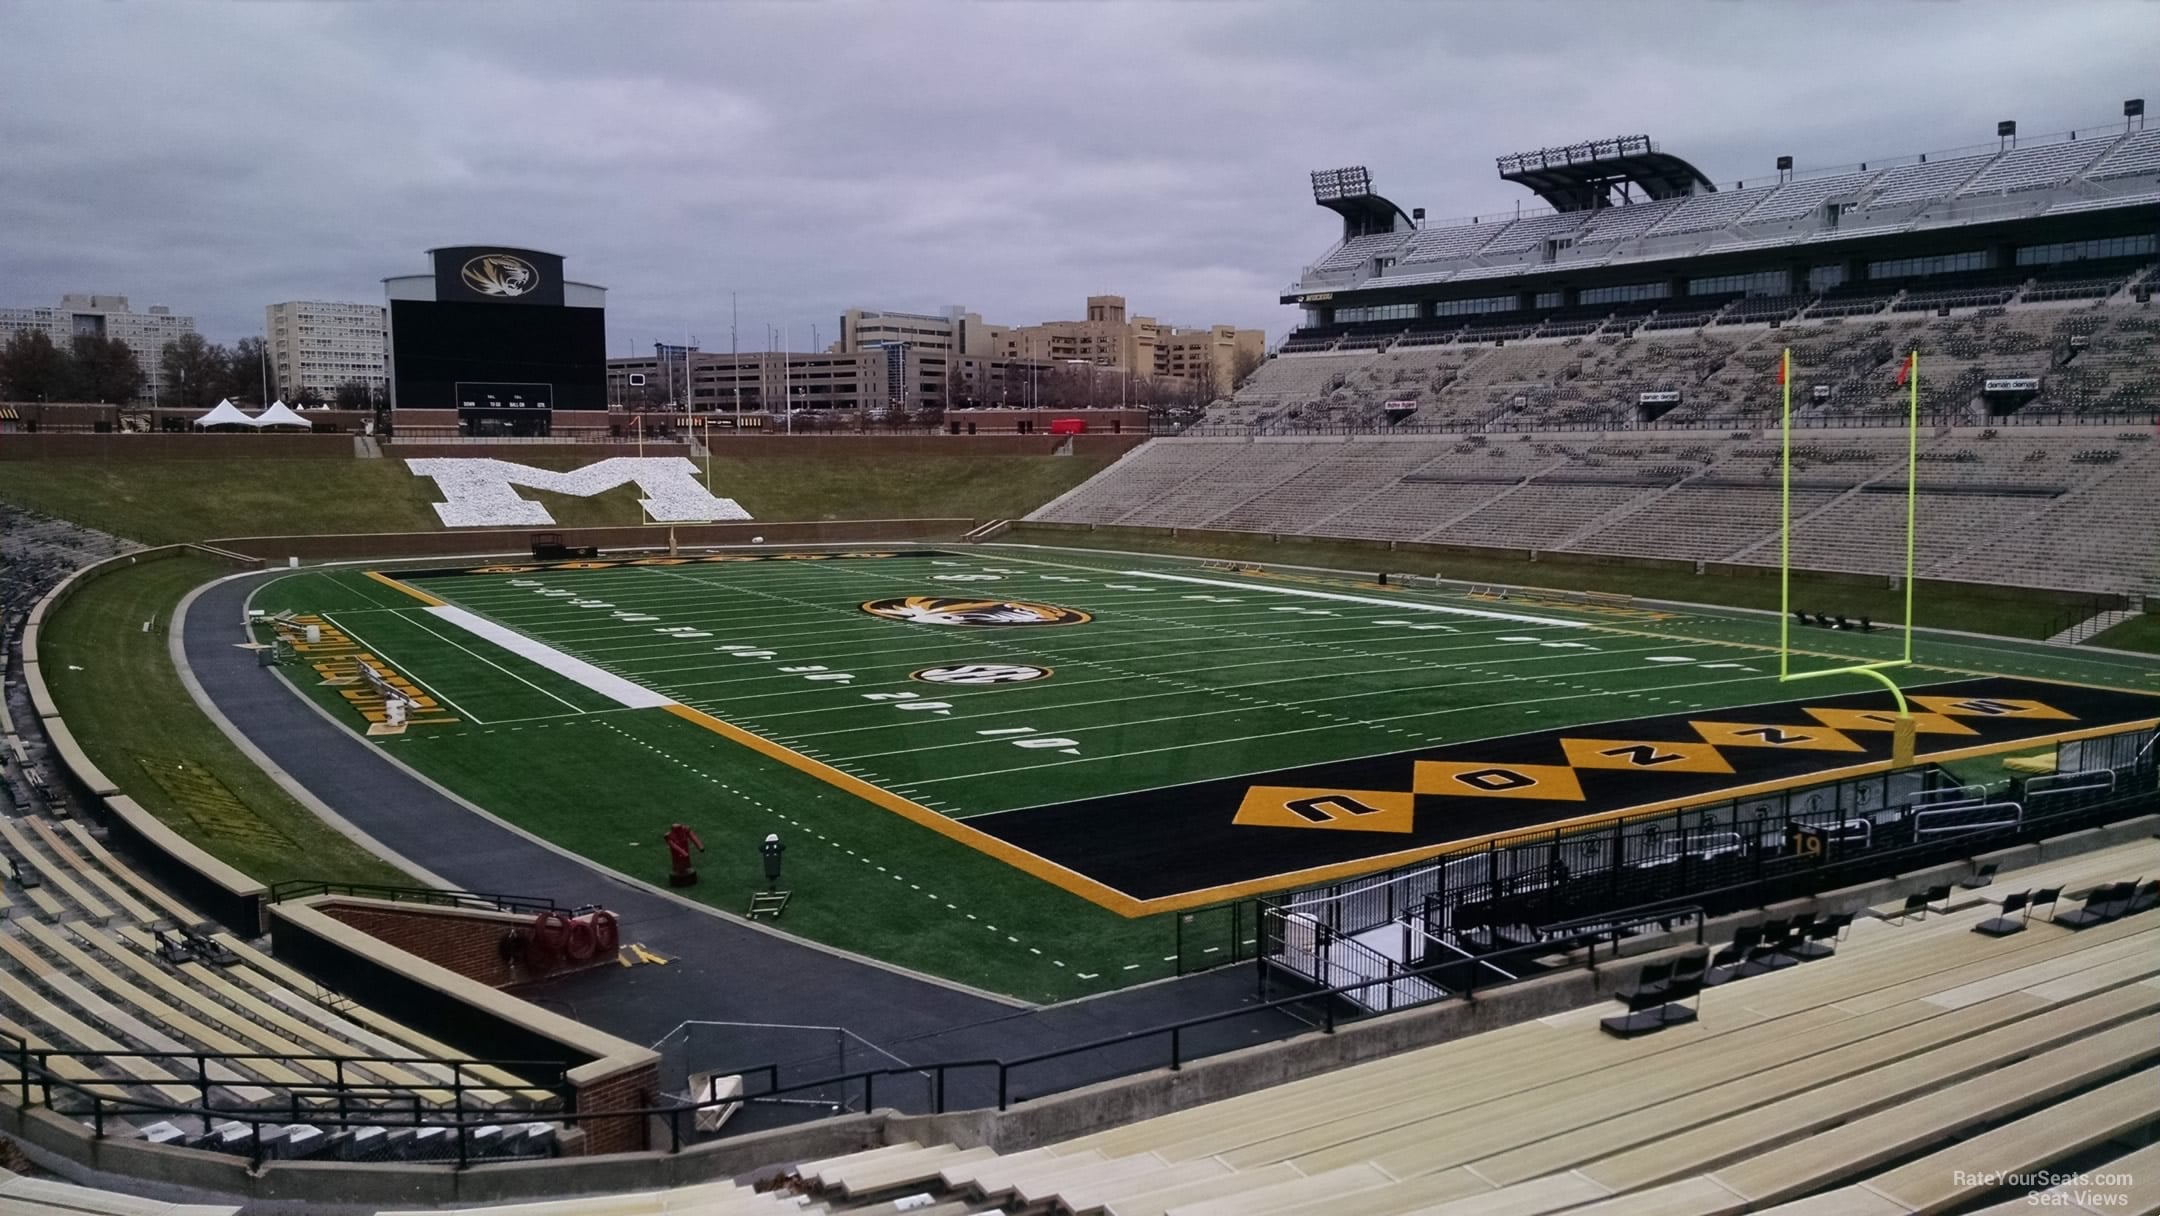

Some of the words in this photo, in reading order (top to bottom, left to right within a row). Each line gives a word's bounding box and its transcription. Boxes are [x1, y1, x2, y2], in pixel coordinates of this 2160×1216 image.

[860, 691, 954, 711] 20
[975, 727, 1081, 748] 10
[1793, 833, 1820, 856] 19
